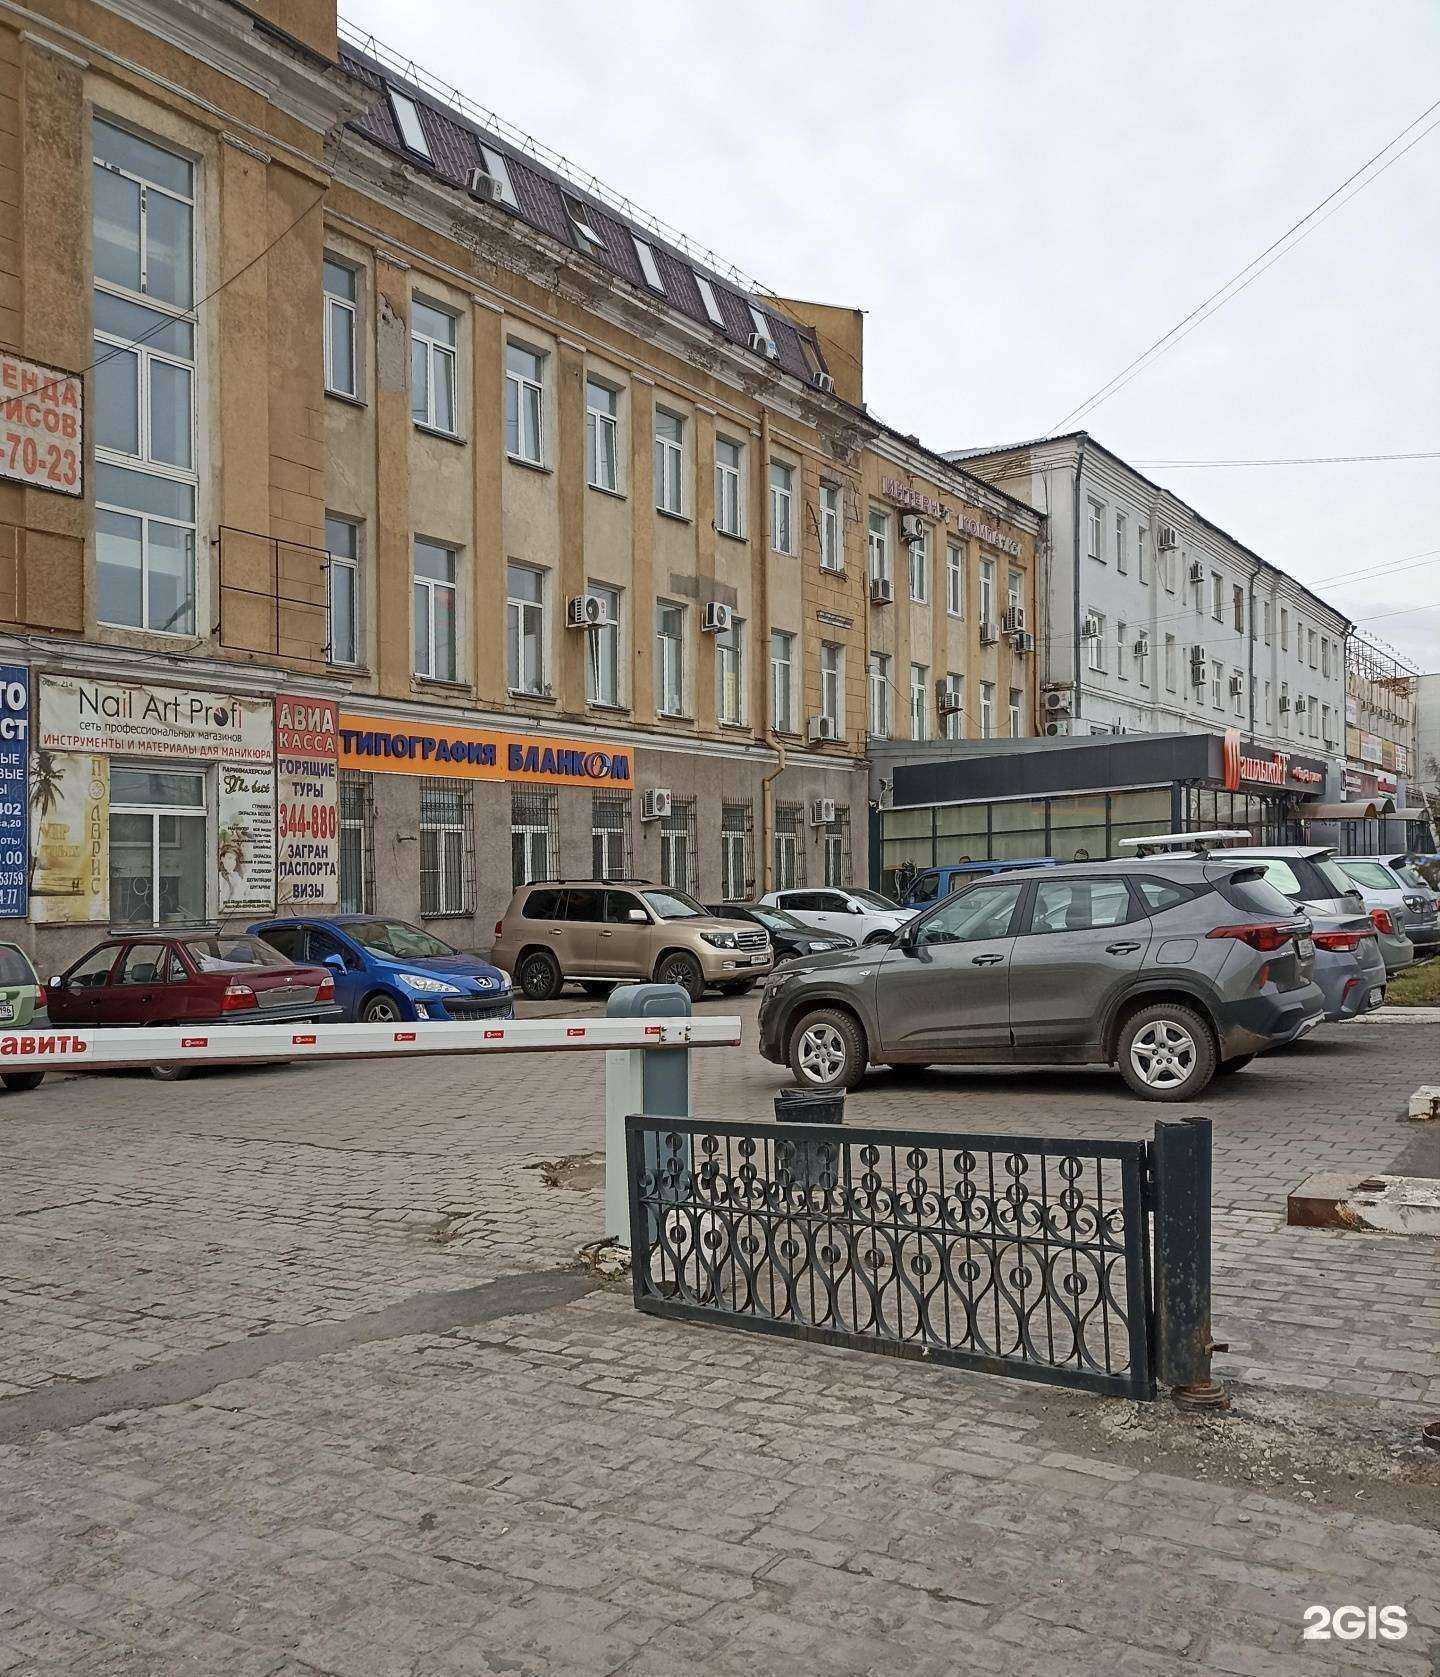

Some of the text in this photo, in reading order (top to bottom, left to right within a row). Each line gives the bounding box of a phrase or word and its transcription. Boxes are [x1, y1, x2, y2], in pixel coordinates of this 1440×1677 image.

[3, 363, 77, 408] ЕНДА
[0, 397, 77, 439] ИСОВ
[0, 431, 77, 486] -70-23
[79, 686, 242, 729] Nail Art Profi
[278, 703, 335, 735] АВИА
[79, 720, 242, 743] сеть профессиональных магазинов
[279, 731, 335, 752] КАССА
[43, 734, 271, 759] ИНСТРУМЕНТЫ И МАТЕРИАЛЫ ДЛЯ МАНИКЮРА
[339, 728, 630, 780] ТИПОГРАФИЯ БЛАНКОМ
[279, 758, 335, 778] ГОРЯЩИЕ
[291, 782, 324, 798] ТУРЫ
[279, 803, 336, 839] 344-880
[288, 844, 328, 860] ЗАГРАН
[279, 861, 336, 877] ПАСПОРТА
[292, 883, 324, 899] ВИЗЫ
[0, 1035, 87, 1056] авить
